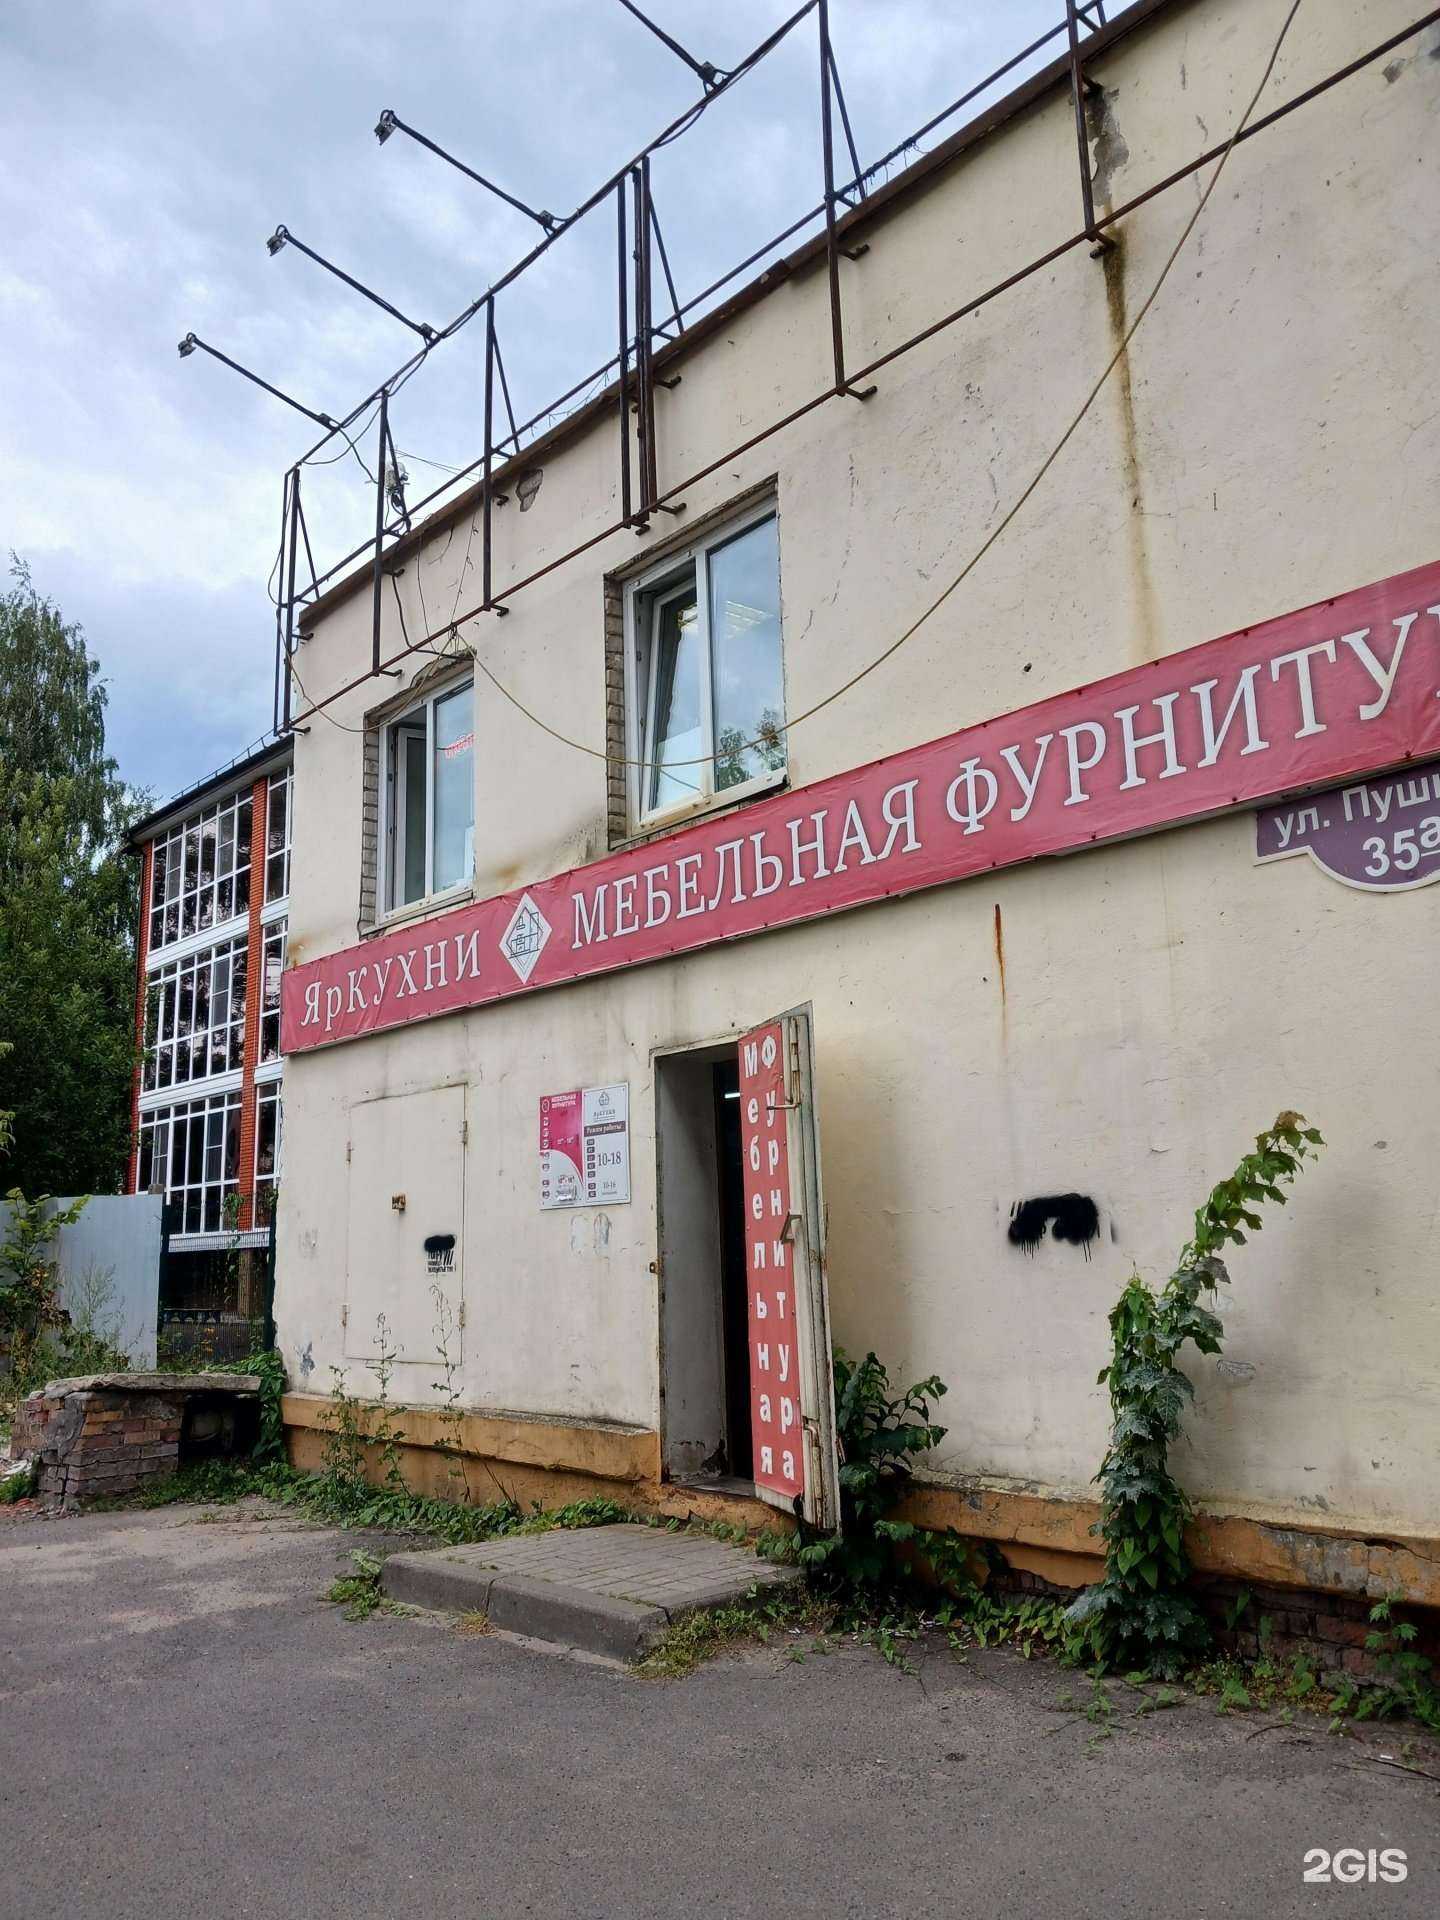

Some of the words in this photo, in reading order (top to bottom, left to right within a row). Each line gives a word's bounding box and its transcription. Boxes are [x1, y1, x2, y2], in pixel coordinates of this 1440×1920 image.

[301, 929, 482, 1032] ЯрКУХНИ
[570, 778, 922, 949] МЕБЕЛЬНАЯ
[945, 603, 1440, 836] ФУРНИТУ
[1274, 807, 1331, 848] ул.
[1362, 815, 1440, 877] 35а
[597, 1151, 622, 1167] 10-18
